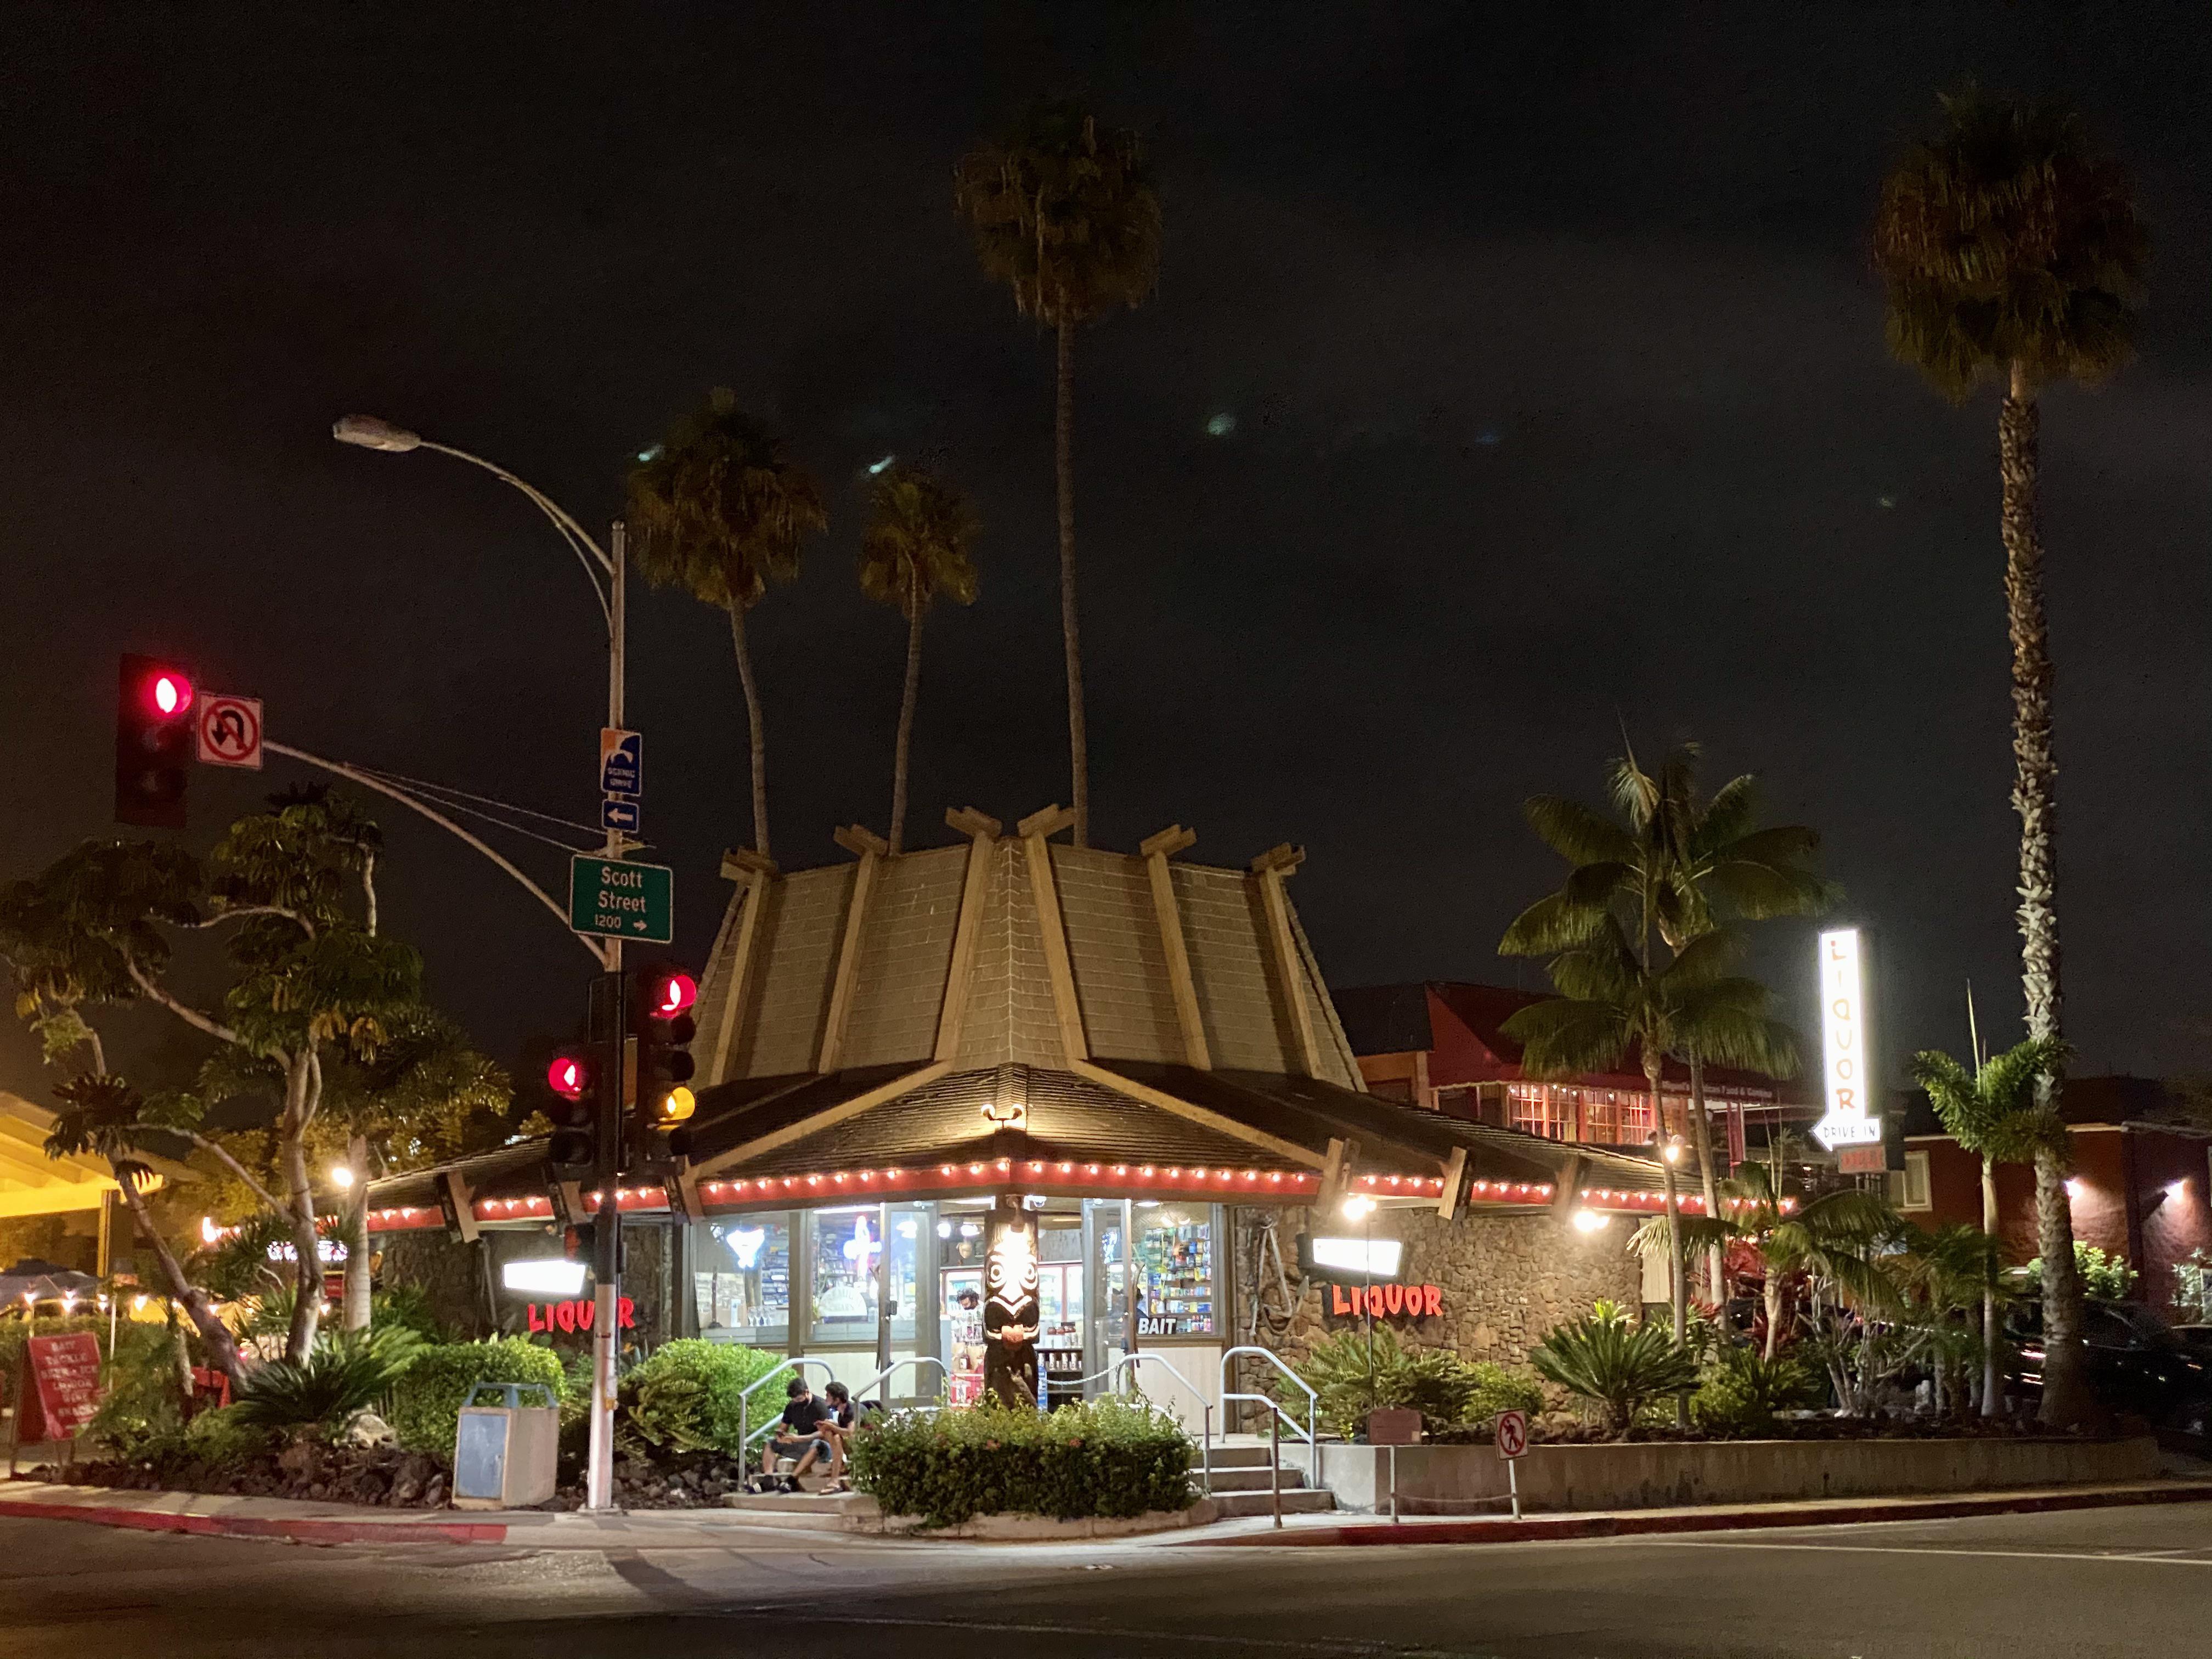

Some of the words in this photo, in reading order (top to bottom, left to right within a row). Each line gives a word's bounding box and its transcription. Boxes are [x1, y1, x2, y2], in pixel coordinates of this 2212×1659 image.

[601, 866, 642, 888] Scott
[598, 890, 645, 913] Street
[595, 914, 621, 928] 1200
[1831, 940, 1856, 1110] LIQUOR
[1824, 1126, 1855, 1138] DRIVE
[1864, 1126, 1875, 1136] IN
[1332, 1283, 1443, 1319] LIQUOR
[527, 1296, 635, 1334] LIQUR
[1138, 1318, 1176, 1334] BAIT
